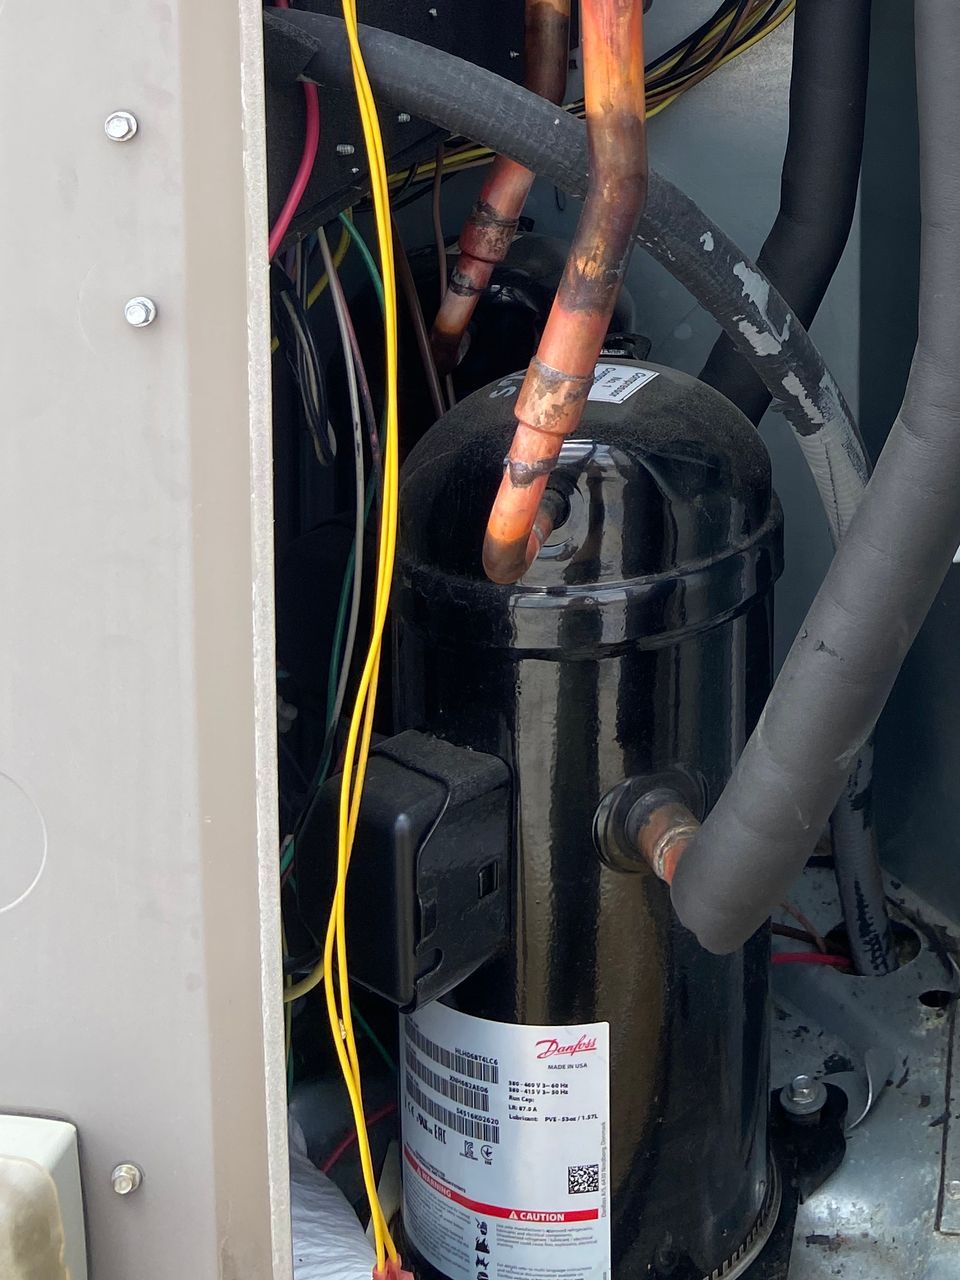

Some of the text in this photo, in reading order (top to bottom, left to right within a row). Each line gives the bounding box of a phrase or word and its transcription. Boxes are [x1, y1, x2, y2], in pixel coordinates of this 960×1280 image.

[535, 1034, 597, 1059] Danfoss
[422, 1173, 452, 1198] WARNING
[520, 1212, 565, 1222] CAUTION
